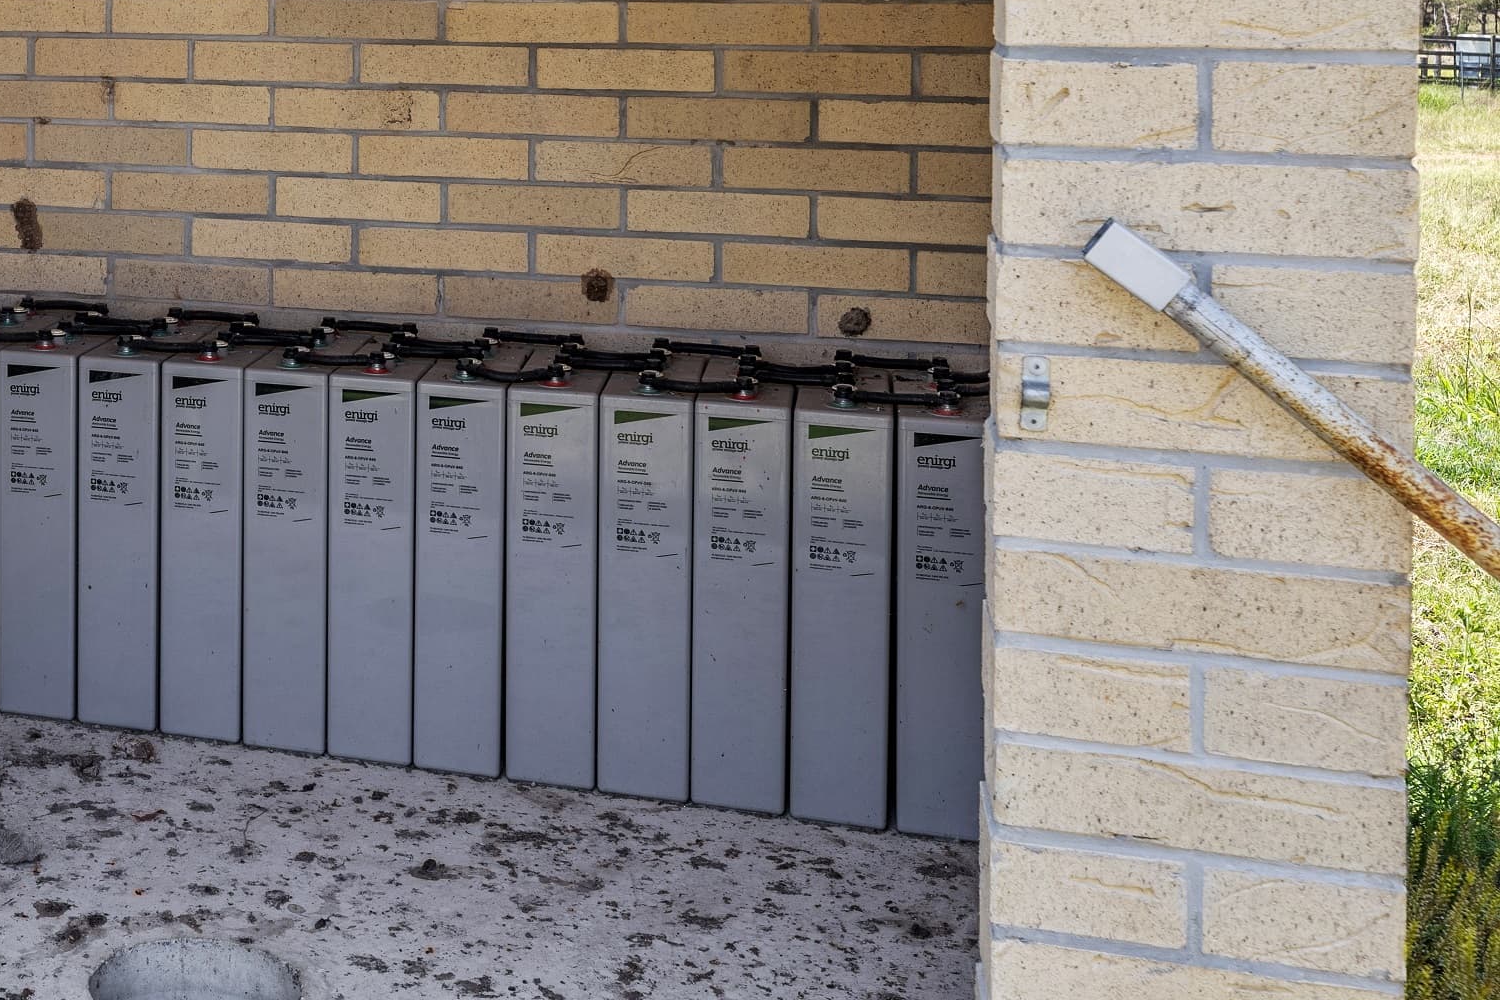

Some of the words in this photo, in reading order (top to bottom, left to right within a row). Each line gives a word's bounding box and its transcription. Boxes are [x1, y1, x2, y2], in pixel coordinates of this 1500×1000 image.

[10, 384, 40, 395] enirgi
[92, 390, 122, 402] enirgi
[175, 396, 206, 408] enirgi
[258, 403, 290, 416] enirgi
[345, 410, 378, 422] enirgi
[432, 417, 466, 430] enirgi
[523, 424, 558, 437] enirgi
[617, 432, 653, 445] enirgi
[432, 444, 459, 452] Advance
[712, 439, 748, 452] enirgi
[812, 447, 850, 461] enirgi
[618, 460, 646, 468] Advance
[917, 455, 956, 469] enirgi
[712, 467, 742, 475] Advance
[812, 476, 842, 484] Advance
[918, 484, 948, 492] Advance
